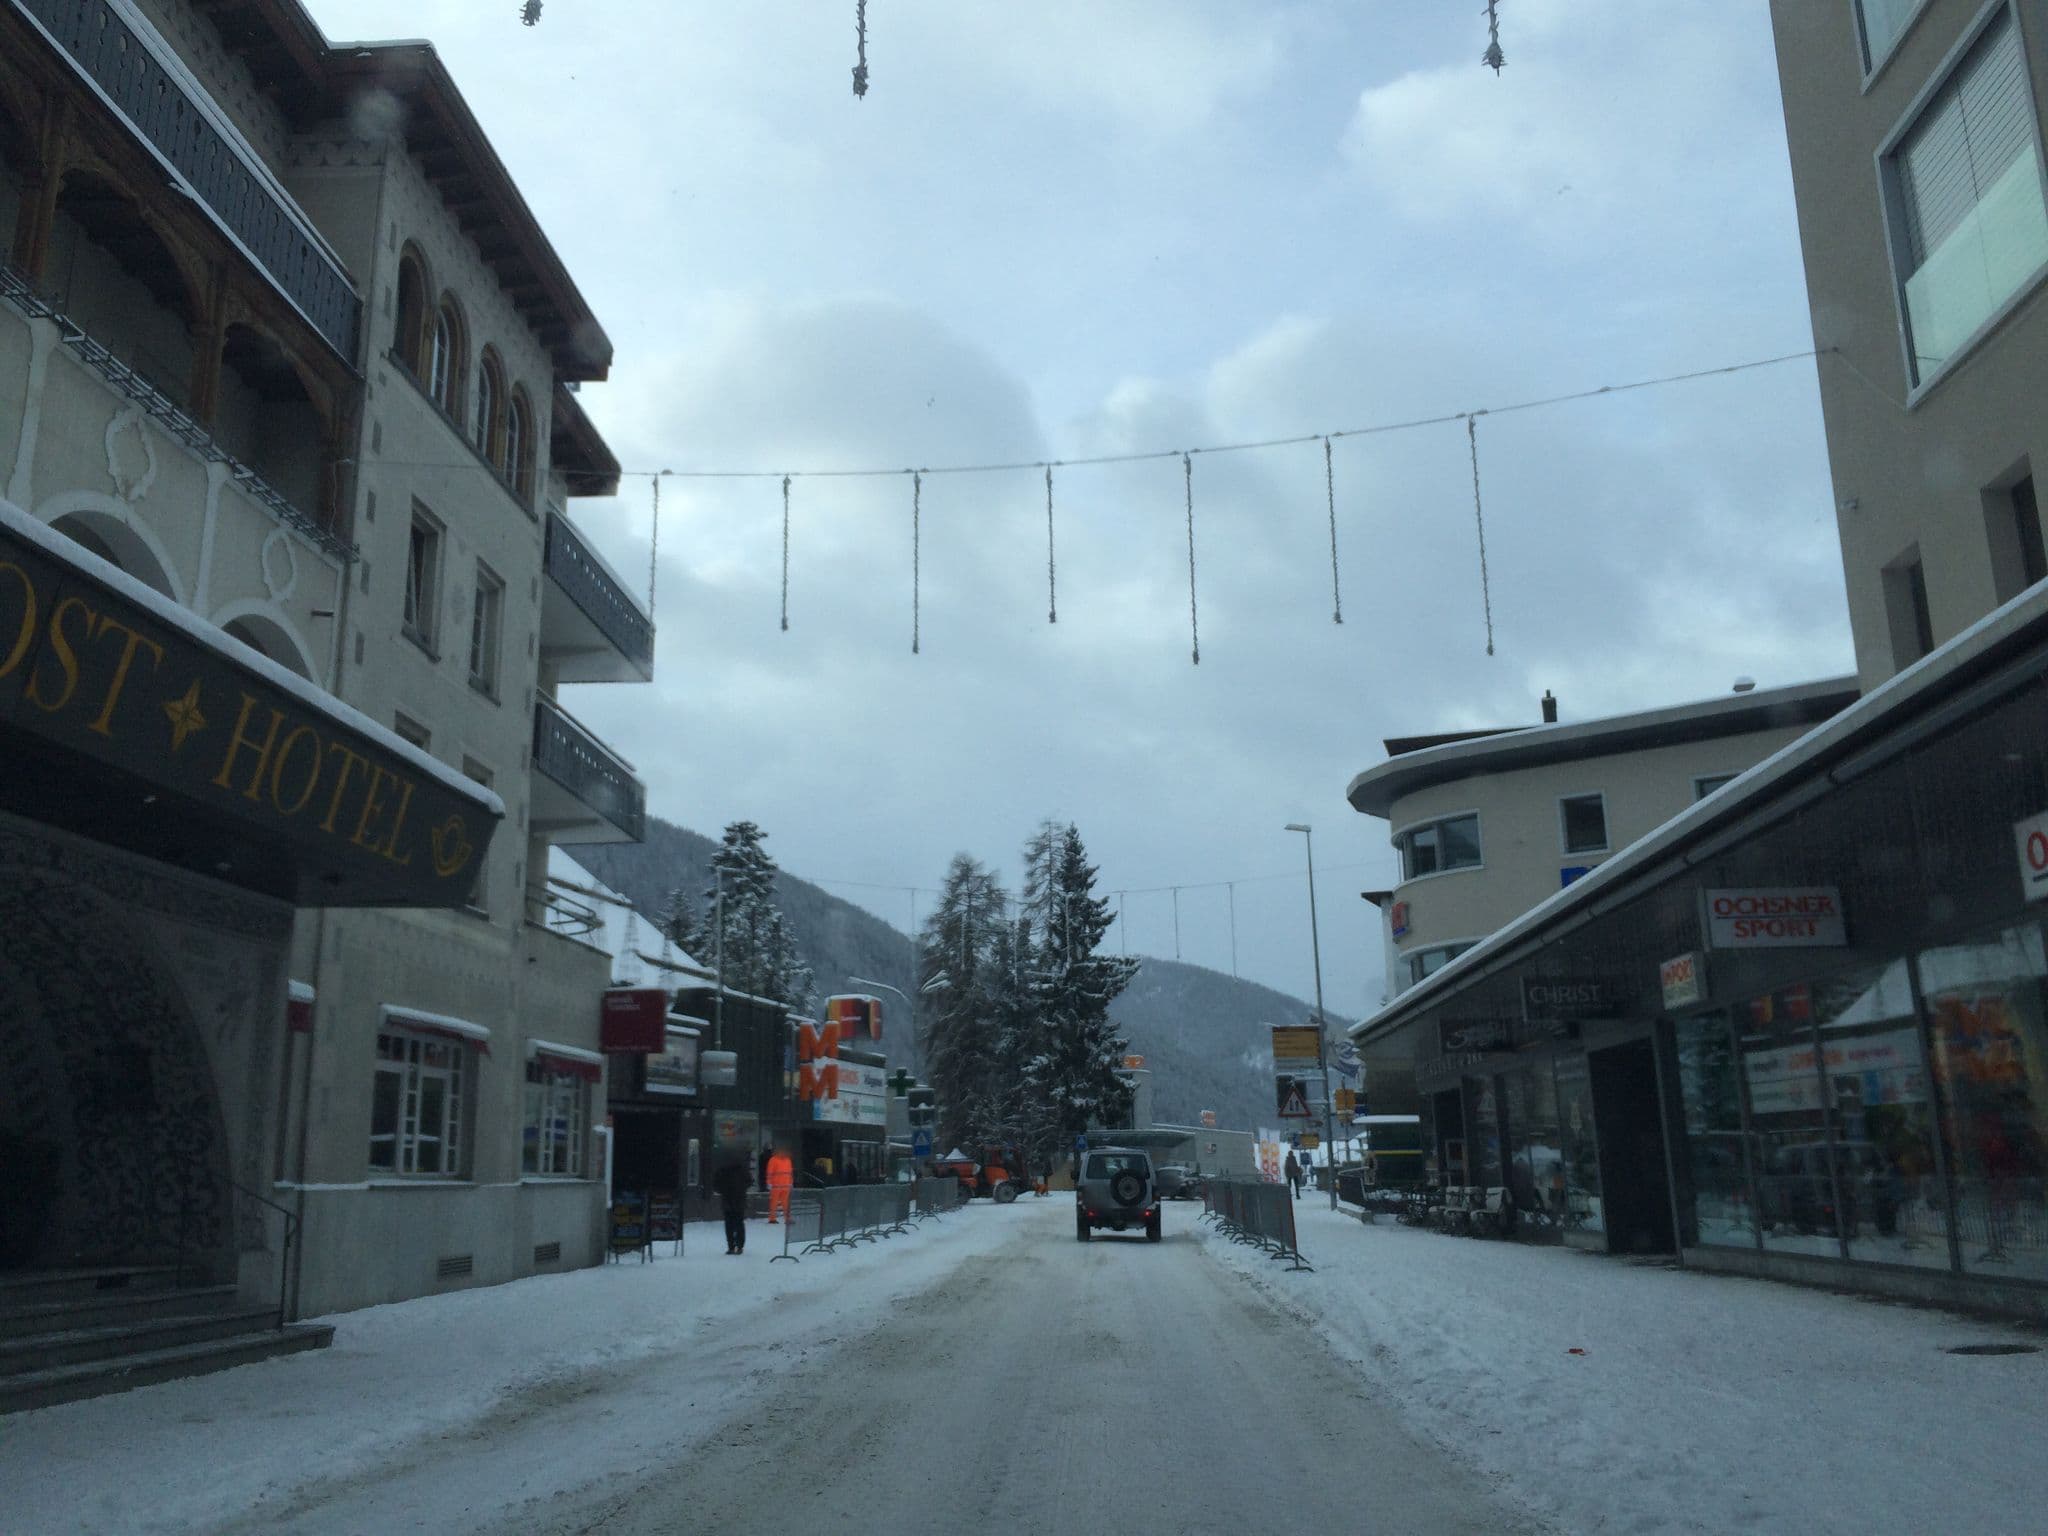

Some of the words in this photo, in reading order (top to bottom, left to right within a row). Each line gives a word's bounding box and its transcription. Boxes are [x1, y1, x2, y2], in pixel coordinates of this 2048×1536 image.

[212, 690, 417, 866] HOTEL
[1712, 895, 1836, 915] OCHSNER
[1733, 918, 1818, 938] SPORT
[1529, 984, 1602, 1004] CHRIST
[800, 1023, 840, 1060] M
[799, 1063, 839, 1102] M
